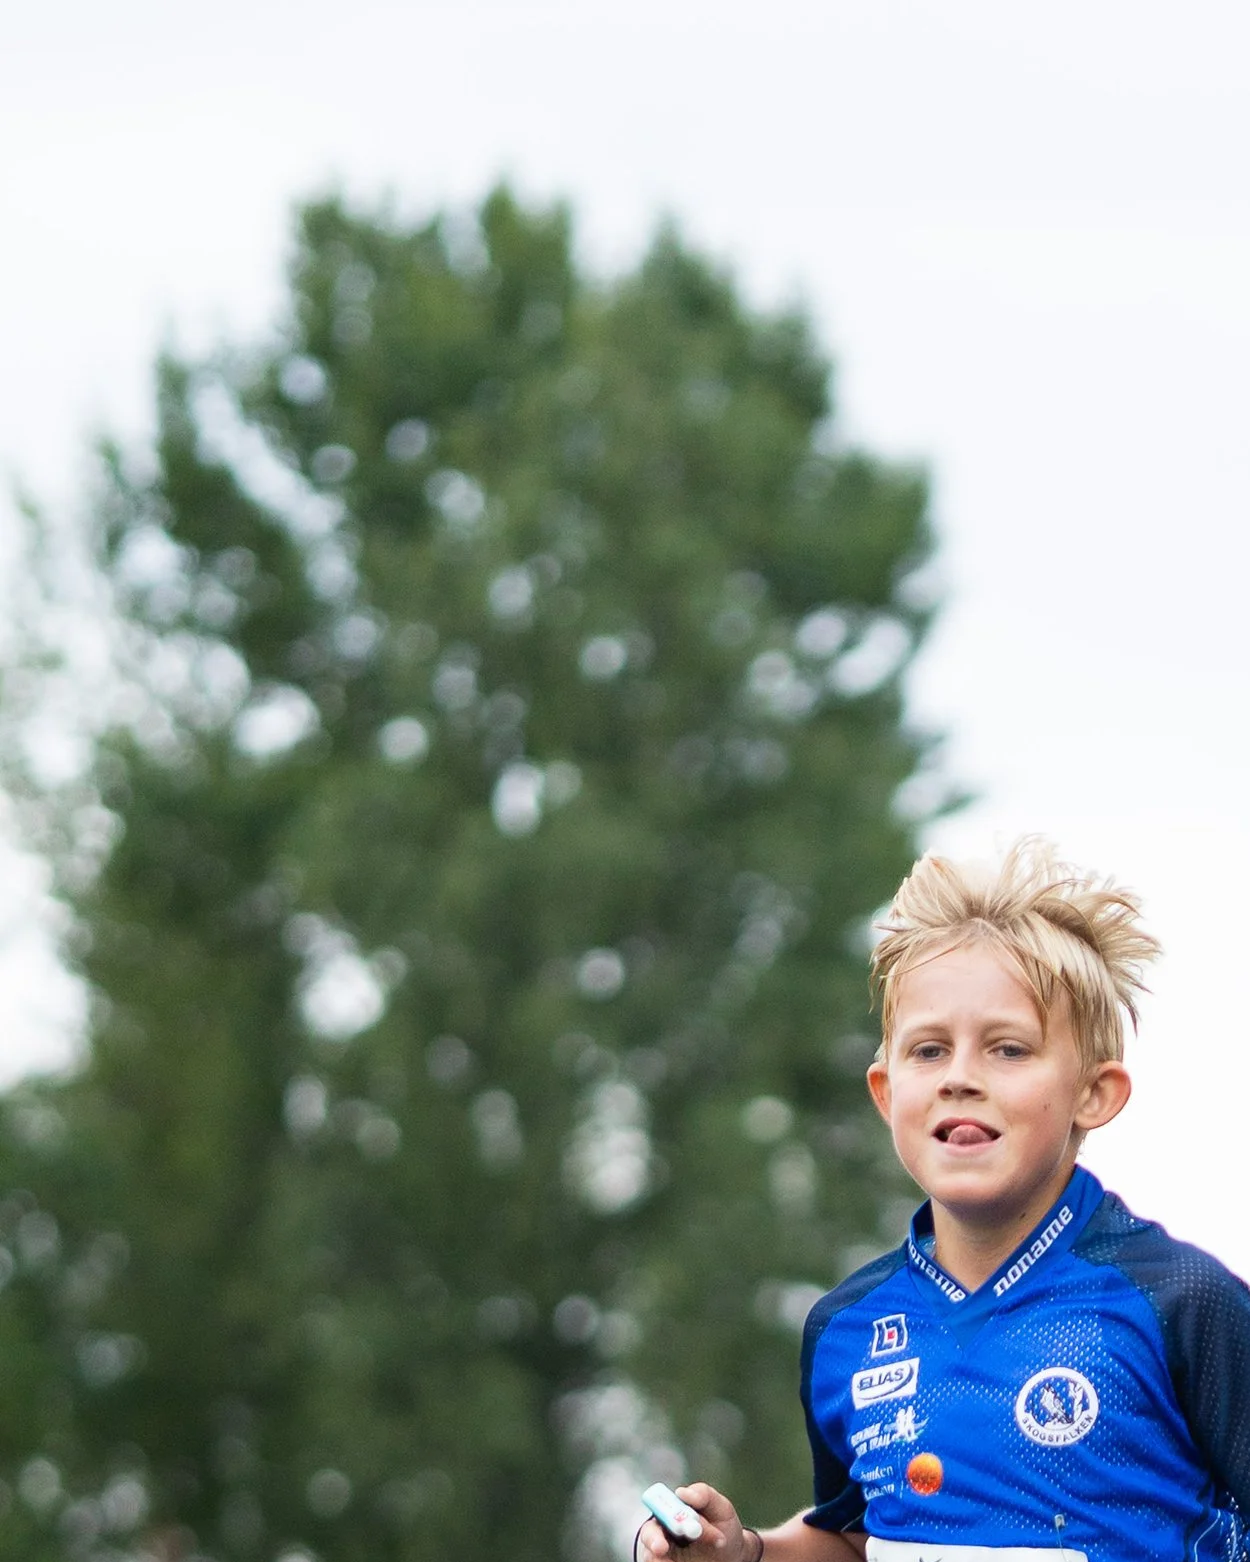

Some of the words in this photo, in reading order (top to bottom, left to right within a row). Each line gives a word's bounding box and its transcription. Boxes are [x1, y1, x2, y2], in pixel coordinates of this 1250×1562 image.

[992, 1205, 1073, 1297] noname
[858, 1367, 905, 1391] ELIAS
[1022, 1414, 1094, 1442] SKOGSFALKEN
